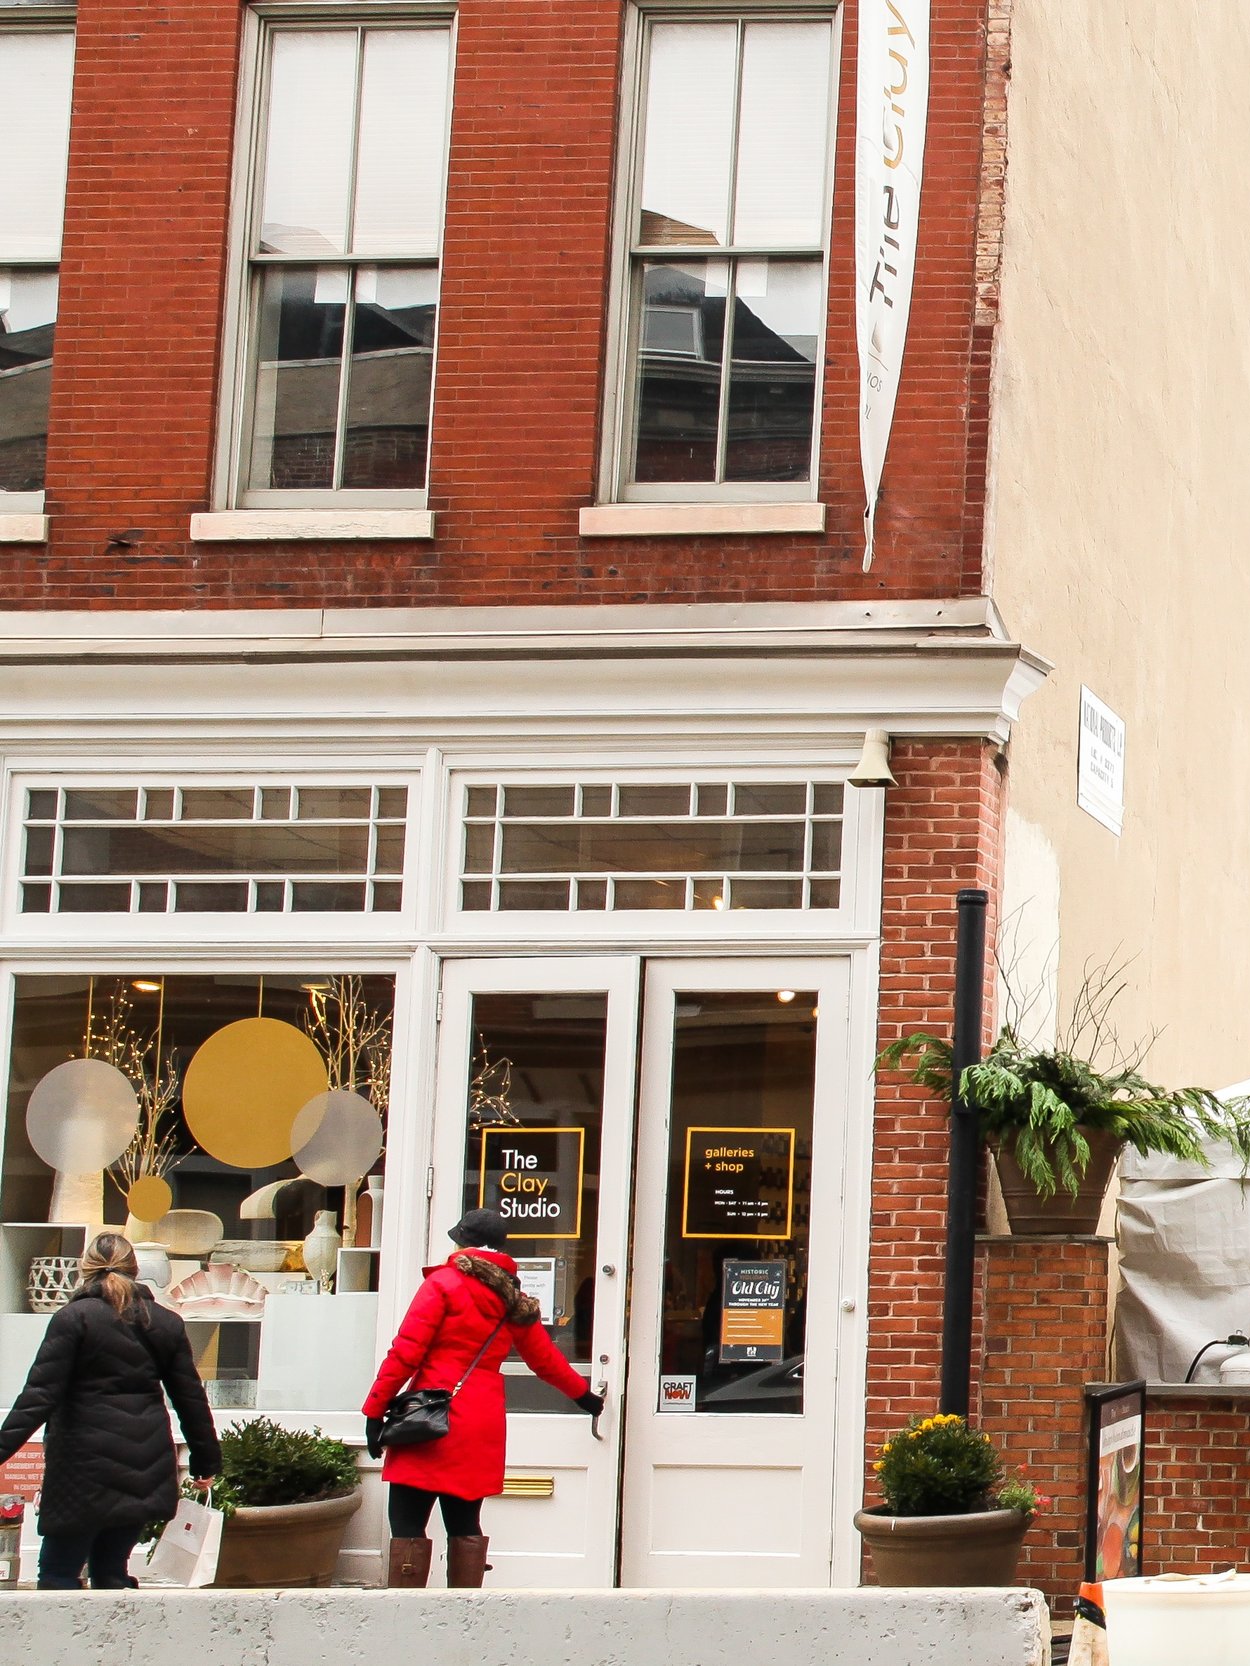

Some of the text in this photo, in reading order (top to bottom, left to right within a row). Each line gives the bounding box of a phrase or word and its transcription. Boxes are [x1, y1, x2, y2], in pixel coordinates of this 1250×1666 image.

[502, 1149, 538, 1169] The
[705, 1147, 755, 1159] galleries
[705, 1161, 744, 1173] + shop
[501, 1172, 548, 1196] Clay
[500, 1197, 560, 1218] Studio
[731, 1281, 780, 1299] Old City
[663, 1381, 694, 1395] CRAFT
